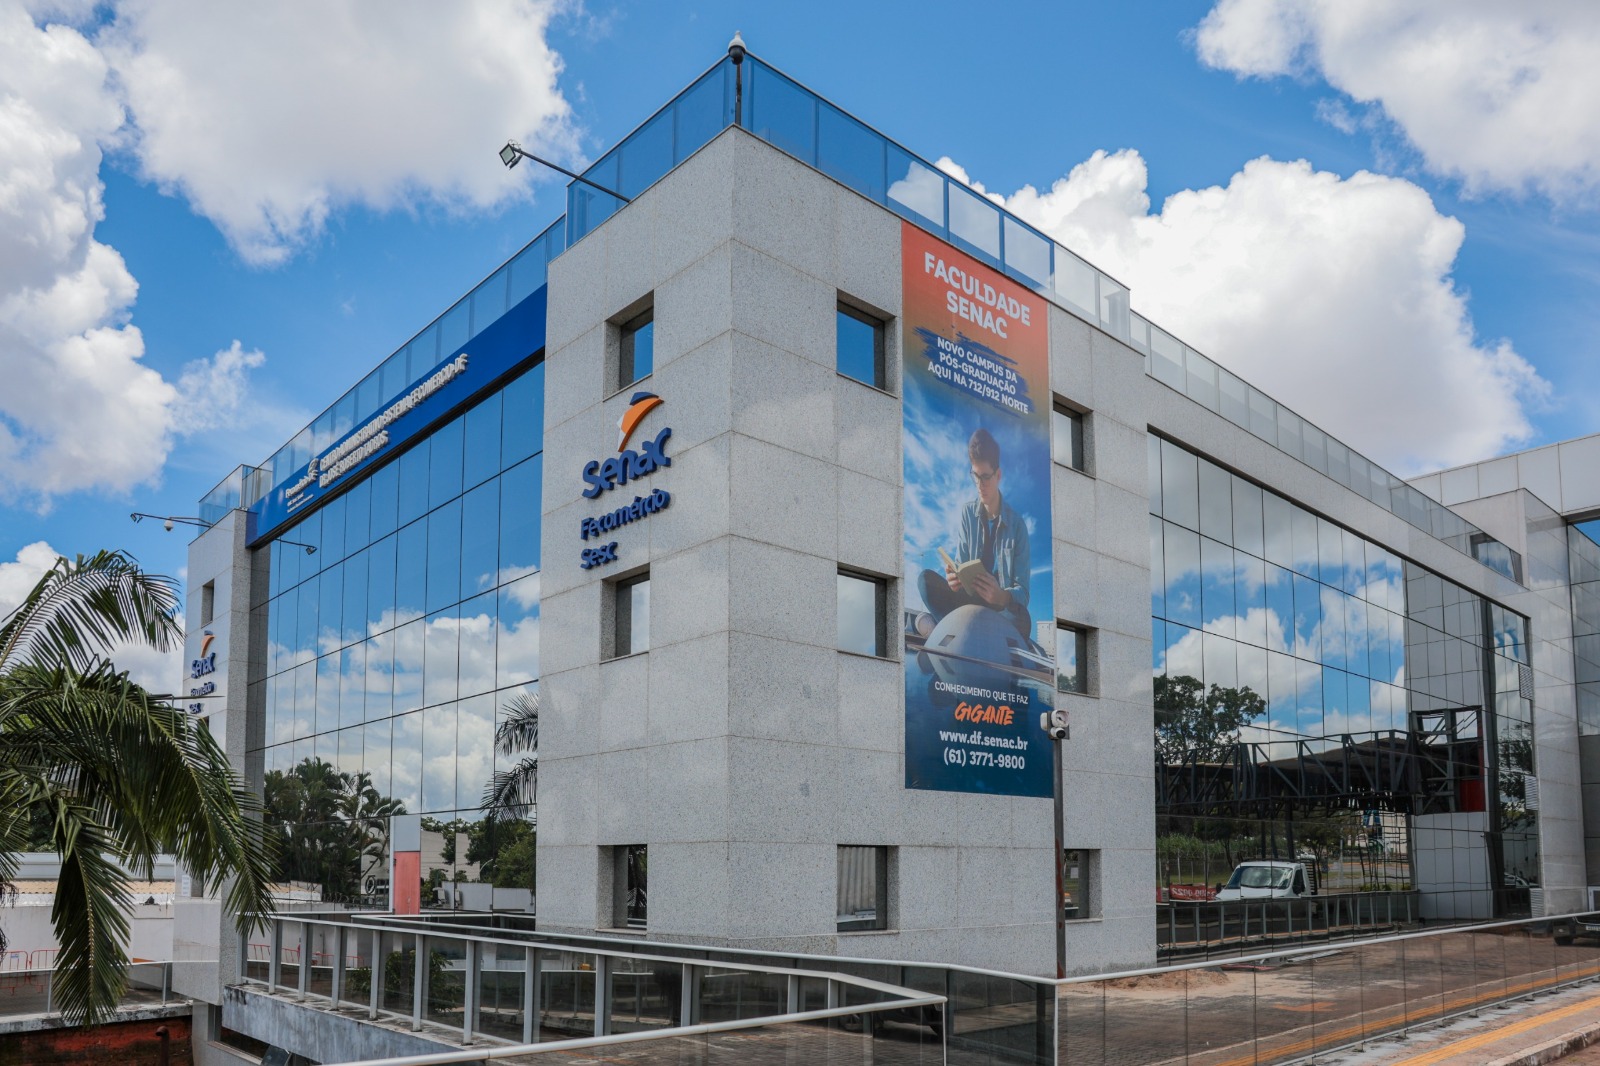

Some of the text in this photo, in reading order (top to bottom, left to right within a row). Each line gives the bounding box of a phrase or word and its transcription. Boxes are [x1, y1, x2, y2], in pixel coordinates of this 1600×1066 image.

[924, 251, 1031, 327] FACULDADE
[946, 290, 1008, 339] SENAC
[937, 337, 1018, 384] NOVO CAMPUS DA
[939, 351, 1016, 396] PÓS-GRADUAÇÃO
[927, 361, 1029, 415] AQUI NA 712/912 NORTE
[580, 488, 671, 540] Fecomércio
[935, 682, 1028, 704] CONHECIMENTO QUE TE FAZ
[955, 702, 1015, 725] GIGANTE
[939, 731, 1028, 750] www.df.senac.br
[944, 747, 1025, 769] (61) 3771-9800
